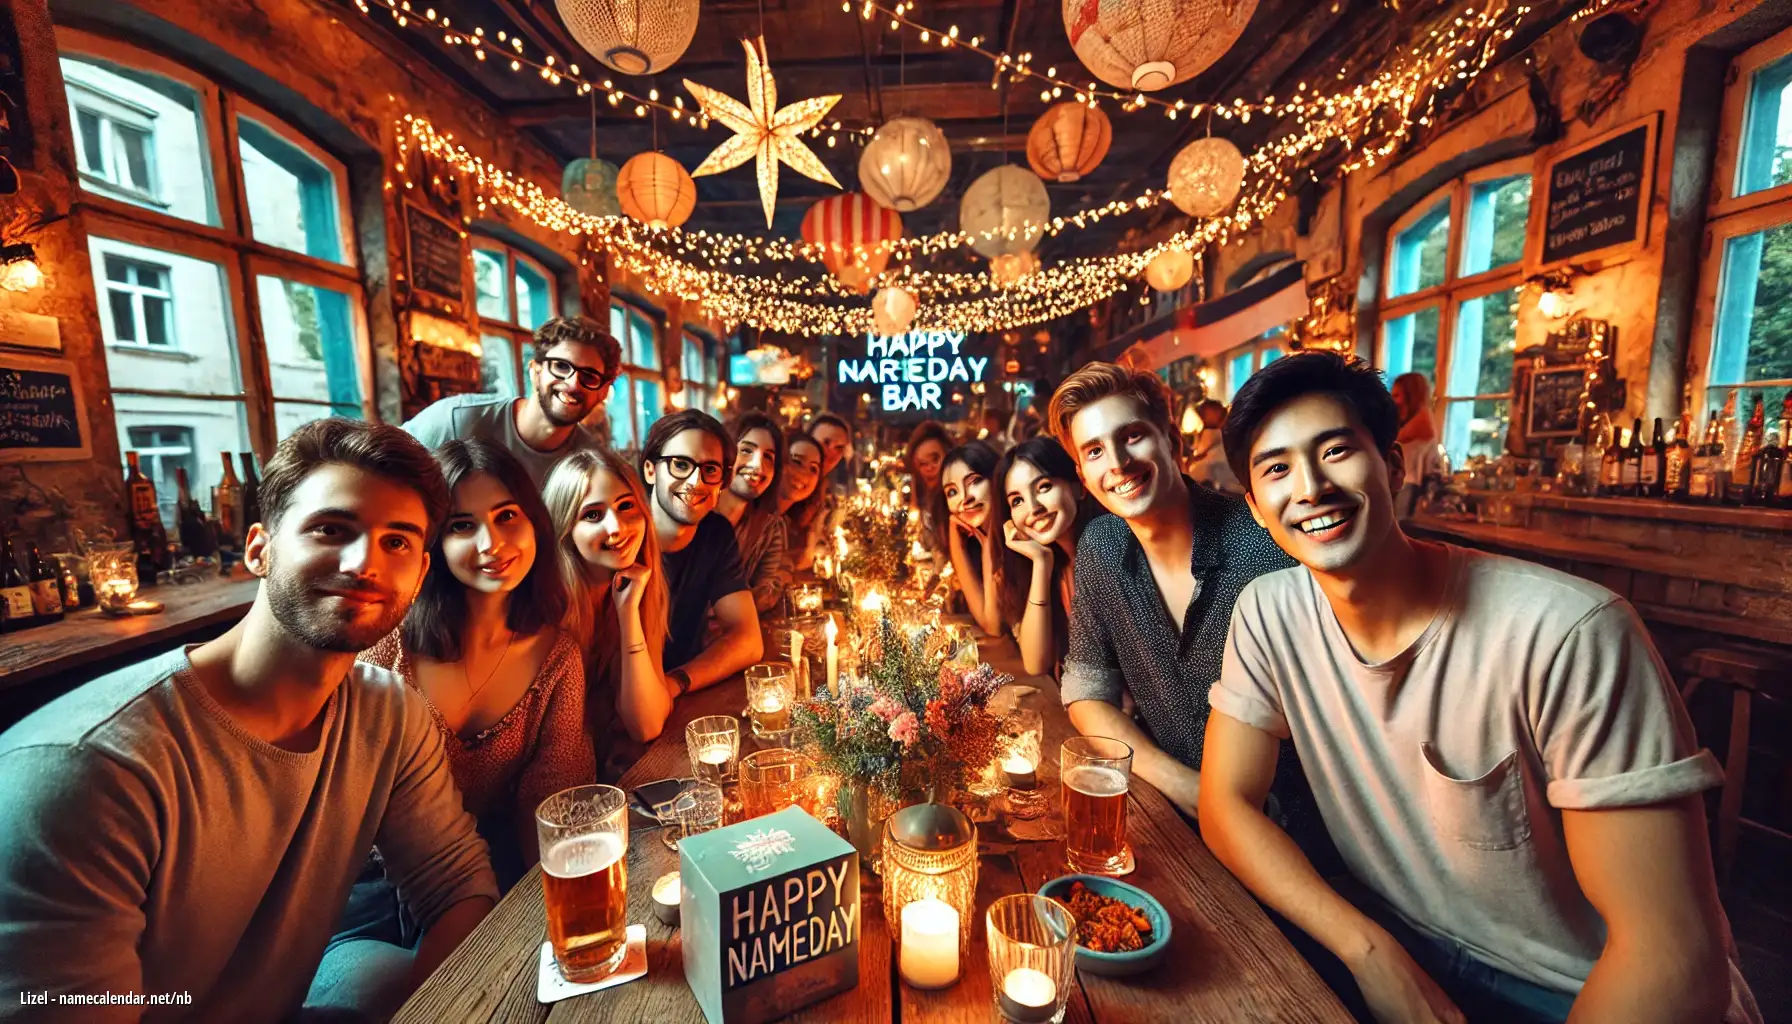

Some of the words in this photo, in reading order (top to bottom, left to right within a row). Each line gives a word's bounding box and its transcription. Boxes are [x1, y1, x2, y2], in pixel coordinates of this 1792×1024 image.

[867, 330, 965, 358] HAPPY
[882, 383, 942, 411] BAR
[732, 860, 848, 940] HAPPY
[728, 903, 856, 987] NAMEDAY
